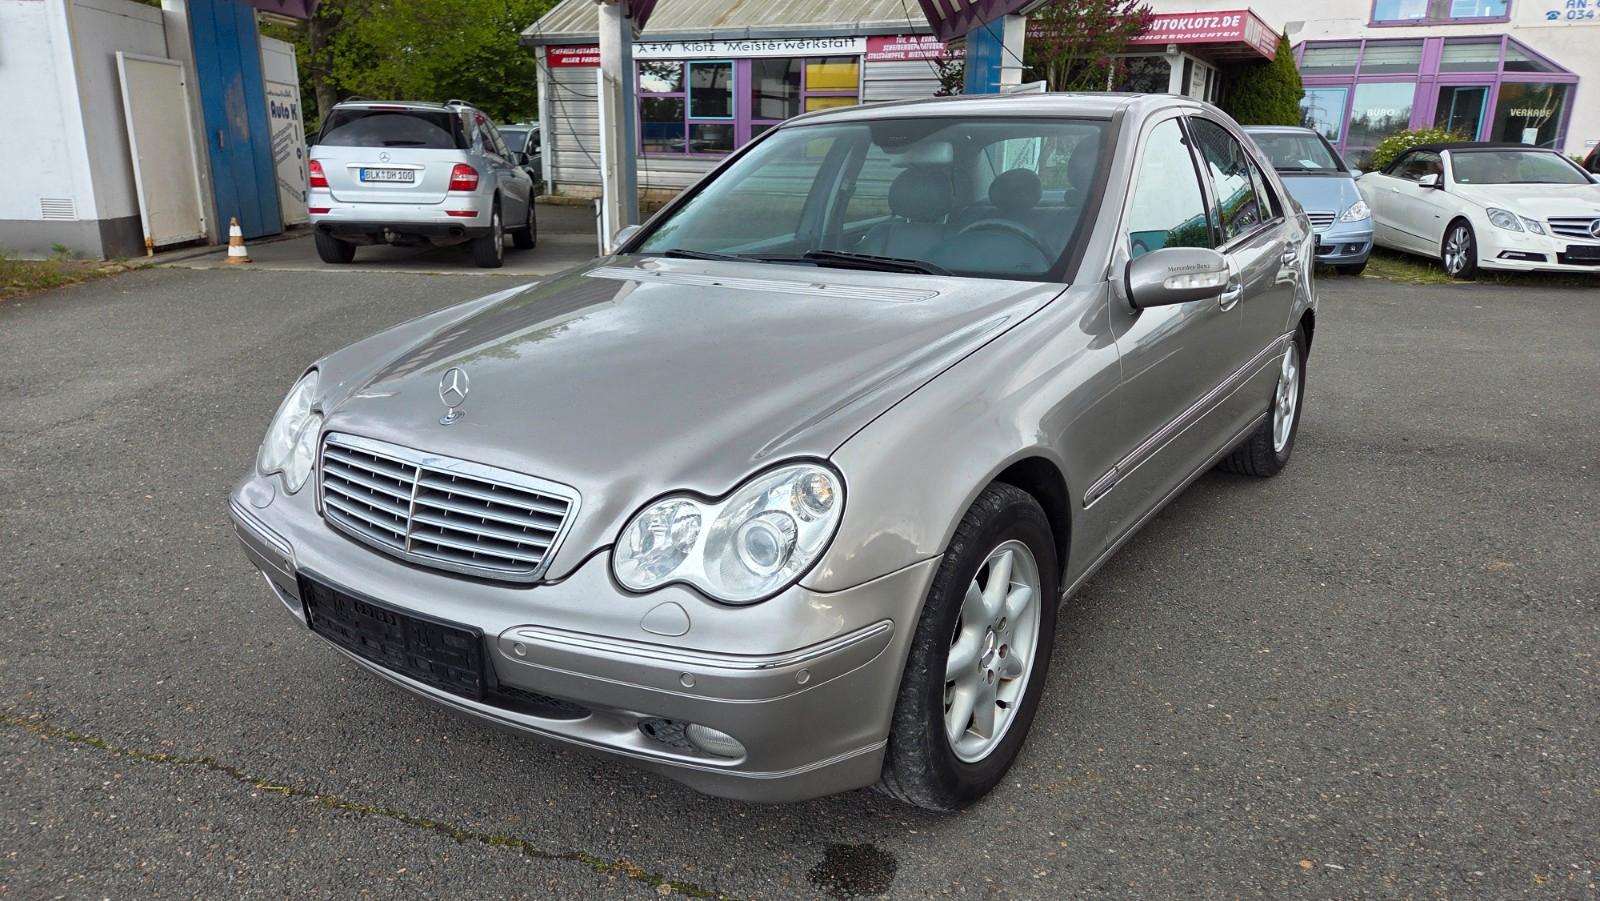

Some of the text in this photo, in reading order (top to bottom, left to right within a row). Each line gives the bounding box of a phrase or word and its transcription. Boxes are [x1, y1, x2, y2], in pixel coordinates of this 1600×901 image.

[682, 42, 716, 52] Klotz
[726, 38, 856, 51] Meisterwerkstatt
[270, 100, 289, 119] Auto
